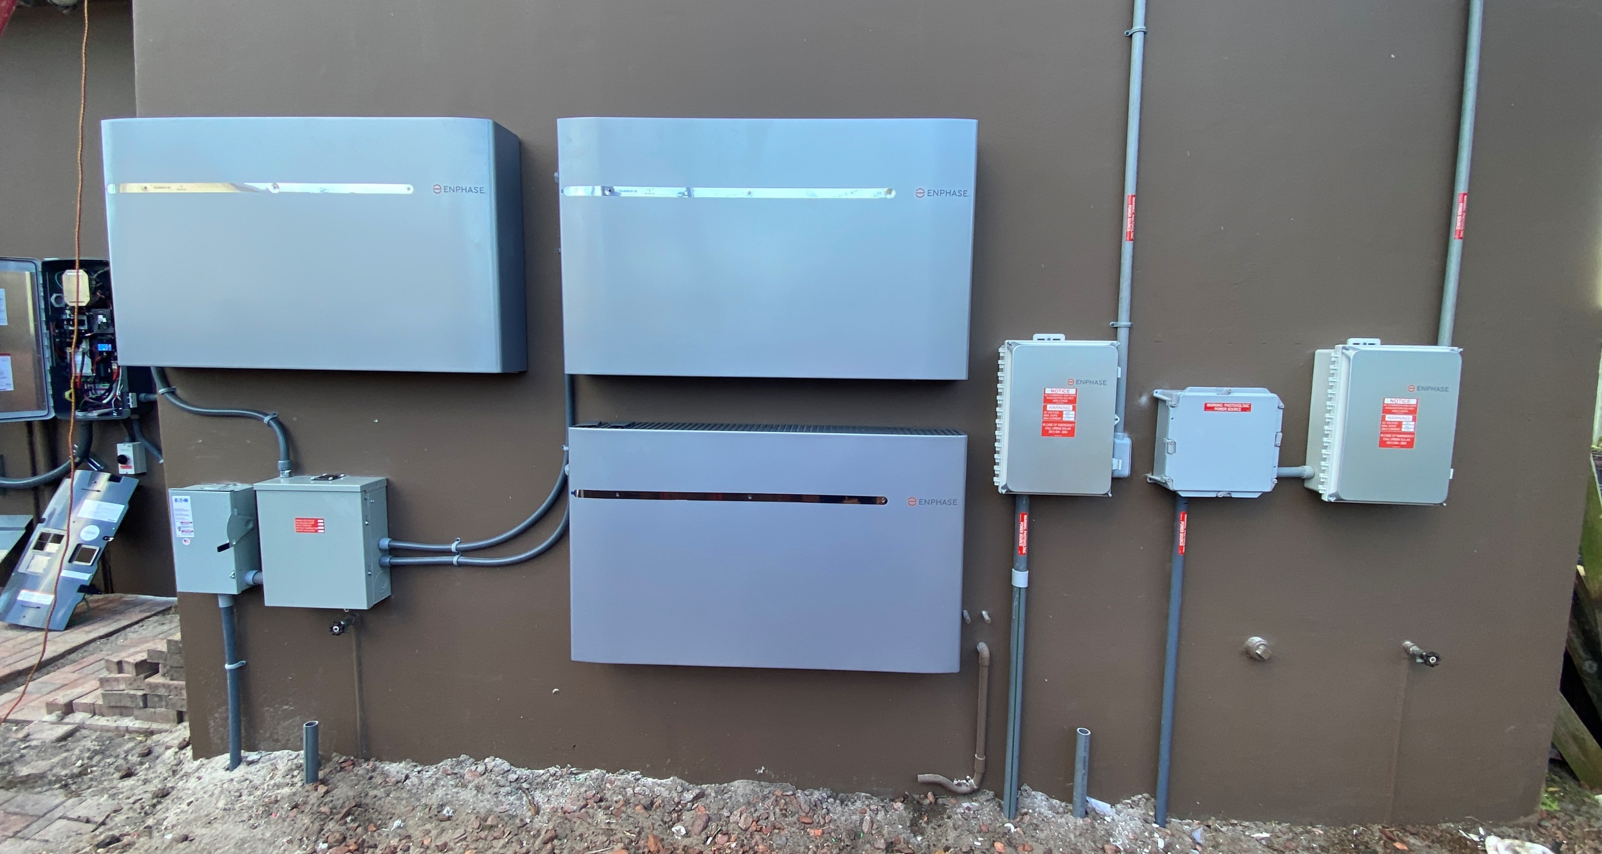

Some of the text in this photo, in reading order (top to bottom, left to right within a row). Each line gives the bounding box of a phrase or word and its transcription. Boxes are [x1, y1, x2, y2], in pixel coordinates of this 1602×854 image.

[443, 185, 485, 194] ENPHASE
[927, 189, 968, 198] ENPHASE
[1416, 385, 1450, 393] ENPHASE
[918, 498, 958, 506] ENPHASE
